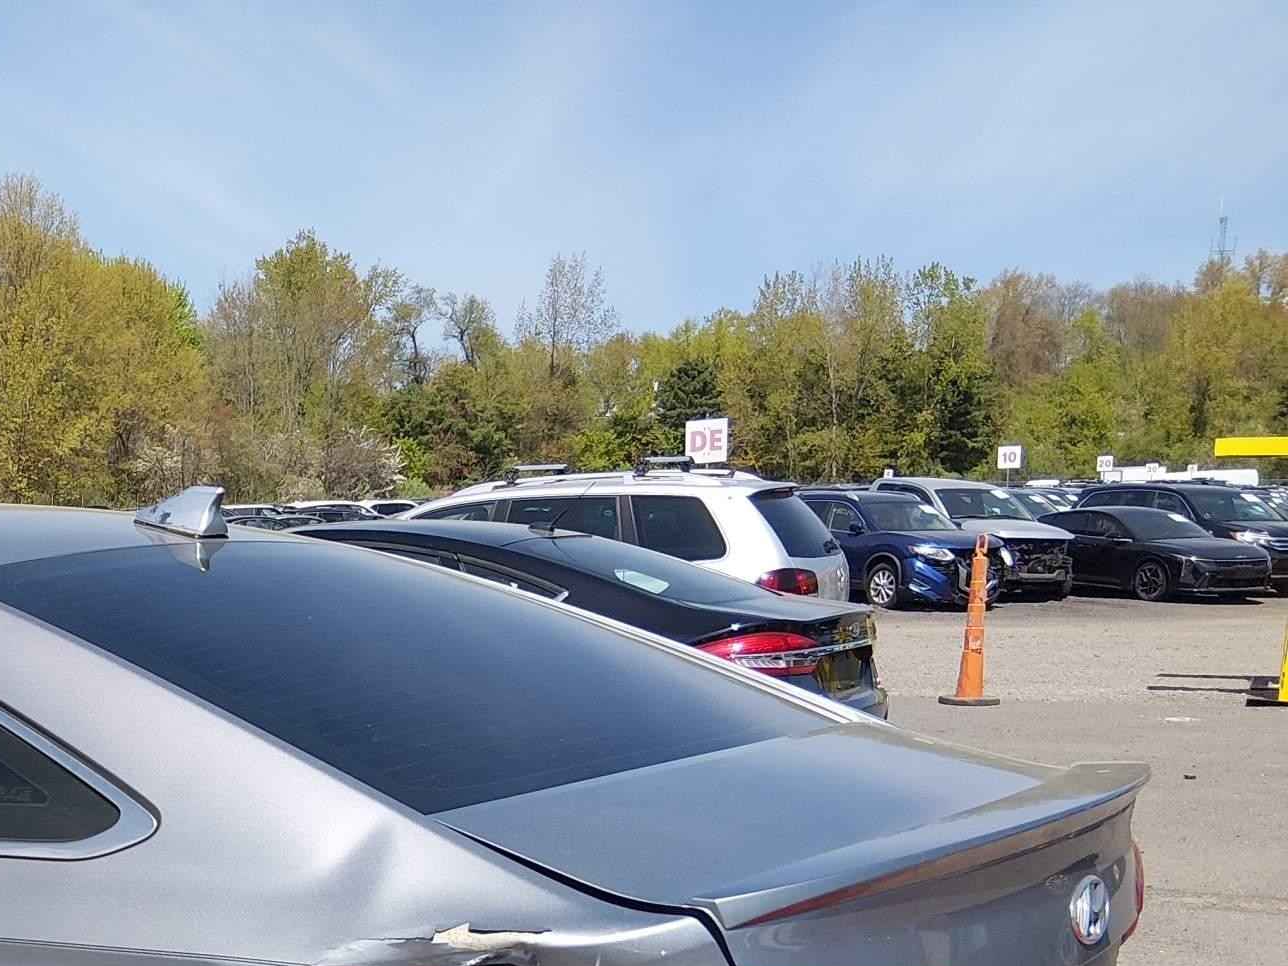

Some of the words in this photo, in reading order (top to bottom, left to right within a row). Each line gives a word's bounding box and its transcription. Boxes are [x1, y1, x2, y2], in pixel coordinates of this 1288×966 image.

[689, 429, 723, 453] DE
[1001, 451, 1017, 463] 10
[1098, 460, 1112, 468] 20
